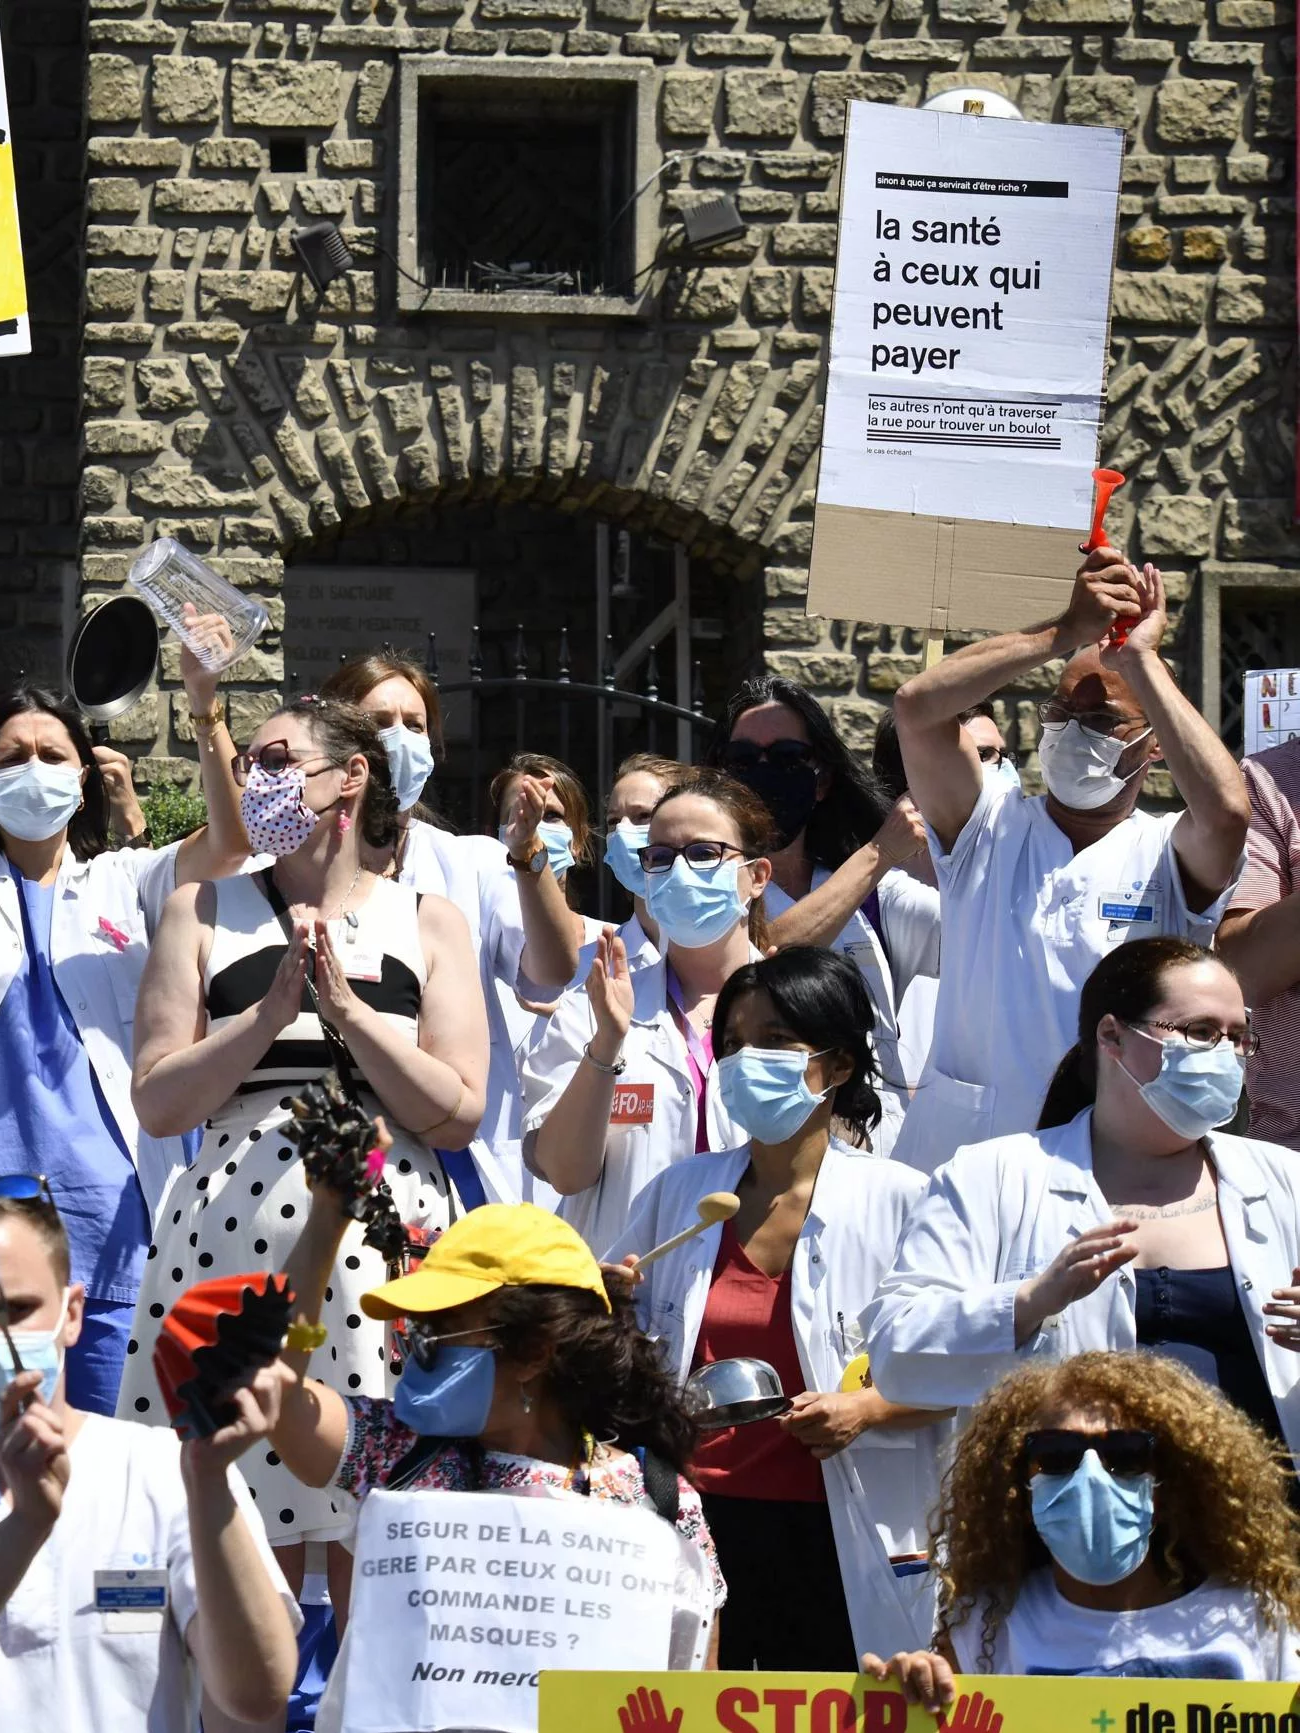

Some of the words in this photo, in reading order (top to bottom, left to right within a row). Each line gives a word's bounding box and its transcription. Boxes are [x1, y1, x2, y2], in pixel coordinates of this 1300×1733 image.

[877, 176, 898, 186] sinon
[900, 177, 906, 186] à
[907, 178, 925, 188] quoi
[926, 180, 937, 189] ça
[938, 180, 971, 190] servirait
[998, 182, 1020, 192] riche
[876, 209, 900, 241] la
[911, 216, 1001, 246] santé
[873, 252, 891, 282] à
[901, 261, 979, 287] ceux
[989, 261, 1041, 295] qui
[872, 301, 1004, 330] peuvent
[871, 343, 961, 374] payer
[868, 399, 886, 411] les
[890, 402, 929, 413] autres
[933, 402, 965, 415] n'ont
[968, 405, 995, 418] qu'à
[999, 406, 1057, 419] traverser
[868, 415, 878, 426] la
[882, 418, 902, 427] rue
[906, 419, 936, 430] pour
[939, 420, 985, 431] trouver
[989, 423, 1005, 432] un
[1009, 421, 1051, 434] boulot
[386, 1521, 468, 1541] SEGUR
[478, 1524, 511, 1542] DE
[520, 1527, 551, 1546] LA
[561, 1532, 646, 1560] SANTE
[361, 1555, 417, 1577] GERE
[425, 1555, 477, 1574] PAR
[486, 1559, 556, 1580] CEUX
[566, 1566, 611, 1587] QUI
[407, 1589, 555, 1614] COMMANDE
[564, 1599, 612, 1620] LES
[429, 1623, 557, 1649] MASQUES
[566, 1633, 580, 1650] ?
[411, 1662, 465, 1682] Non
